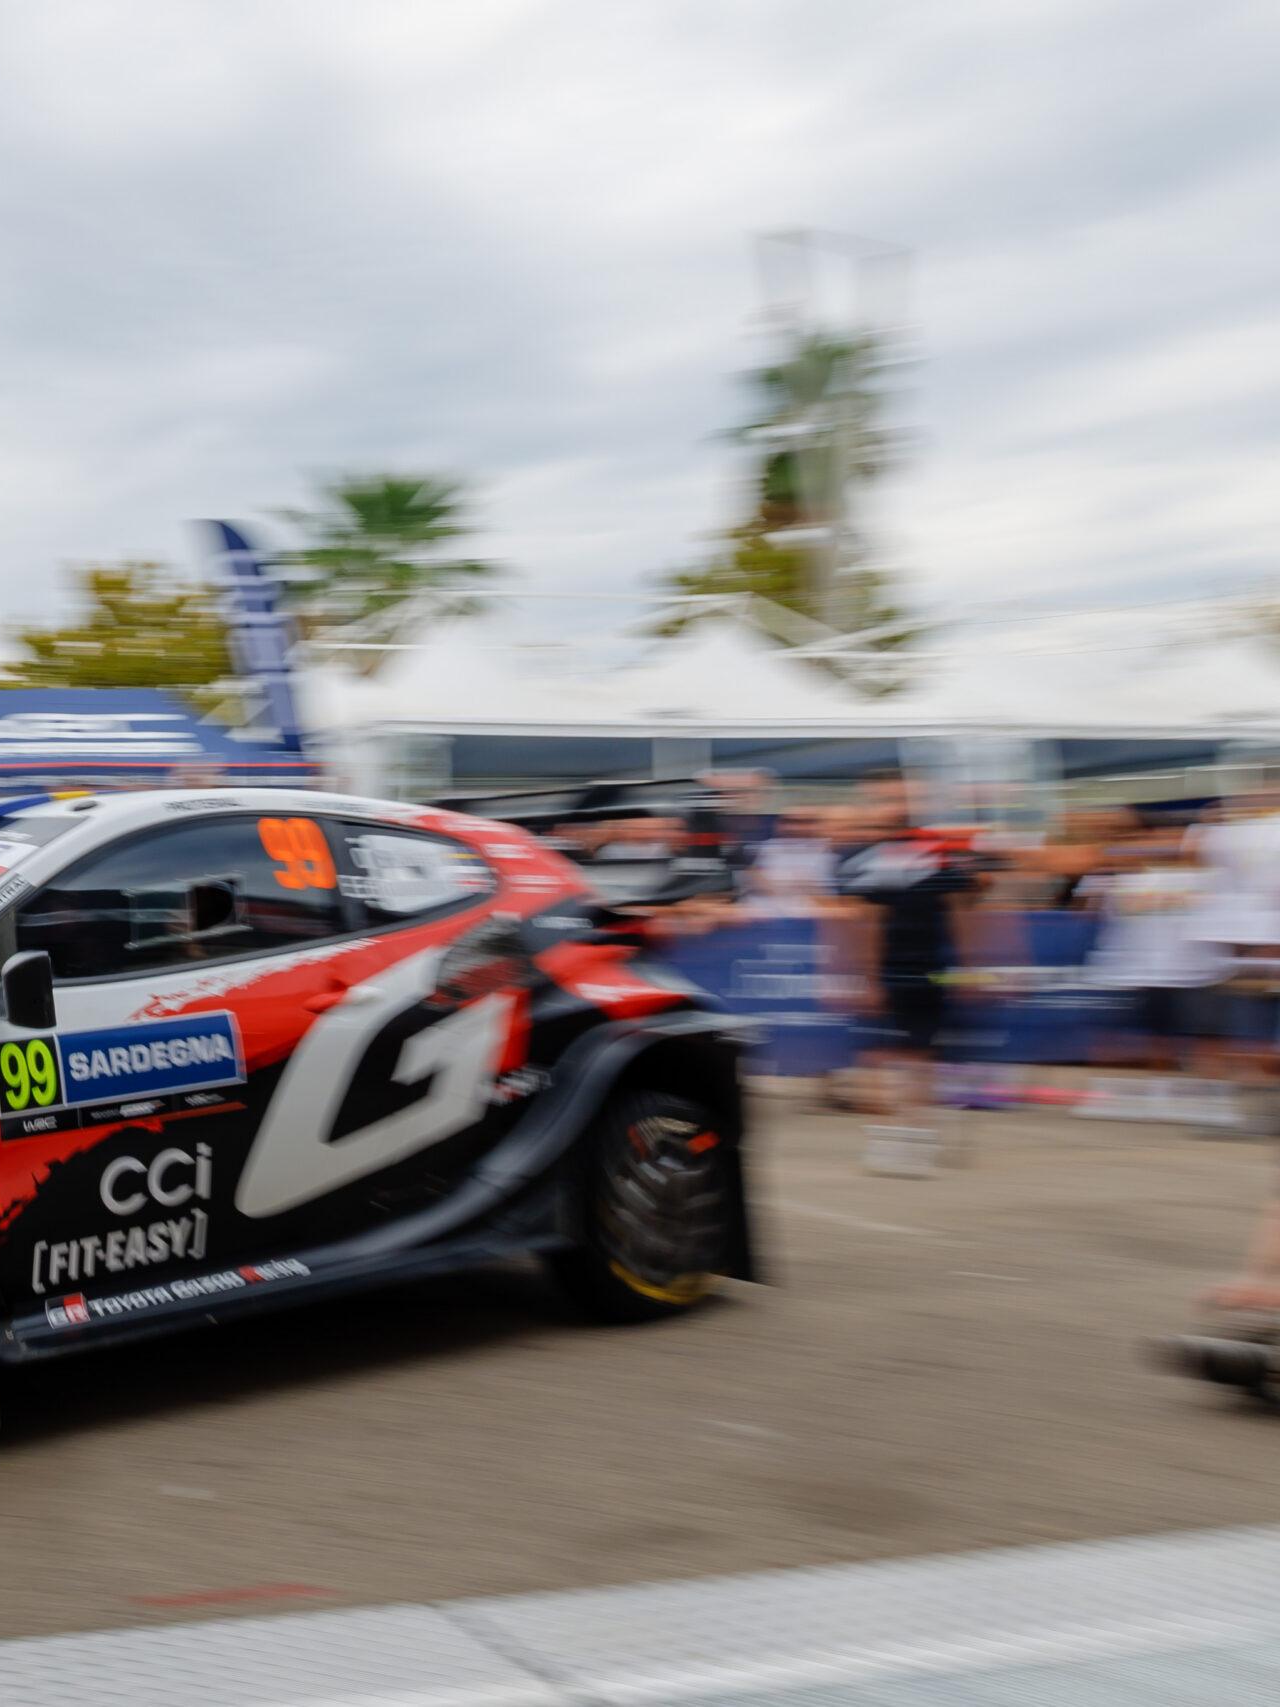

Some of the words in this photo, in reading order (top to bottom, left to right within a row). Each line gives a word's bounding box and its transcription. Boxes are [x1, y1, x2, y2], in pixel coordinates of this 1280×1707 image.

[257, 817, 337, 890] 99
[0, 1039, 57, 1110] 99
[69, 1033, 234, 1081] SARDEGNA
[88, 1286, 175, 1317] TOYOTA
[170, 1270, 247, 1300] GAZOO
